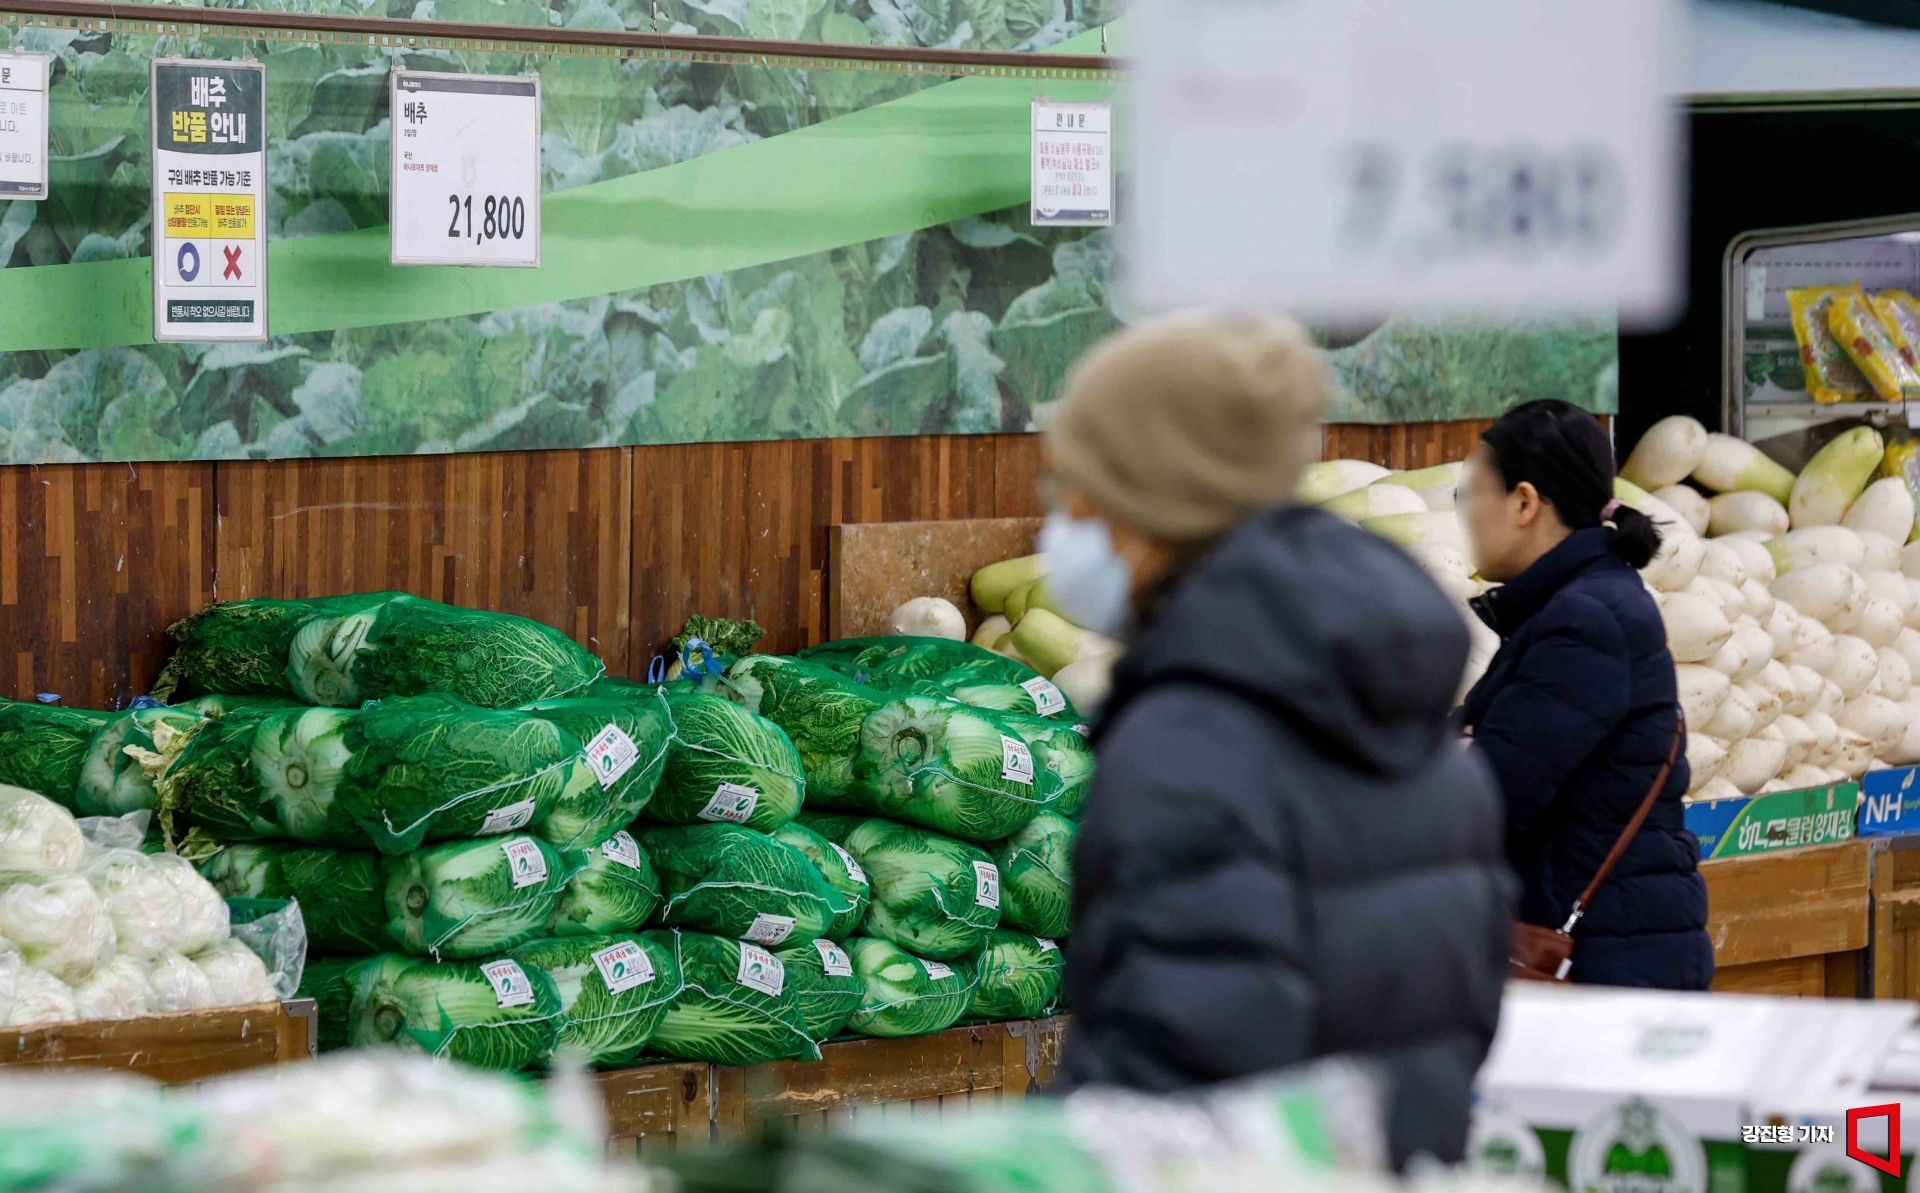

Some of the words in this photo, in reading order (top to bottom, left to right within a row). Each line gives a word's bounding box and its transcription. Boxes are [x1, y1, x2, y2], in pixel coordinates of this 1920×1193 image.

[191, 76, 226, 108] 배추
[172, 112, 207, 142] 반품
[210, 112, 246, 144] 안내
[404, 102, 428, 124] 배추
[168, 169, 183, 186] 구입
[184, 170, 201, 186] 배추
[203, 170, 218, 186] 반품
[220, 171, 235, 186] 가능
[236, 171, 251, 186] 기준
[448, 194, 525, 246] 21,800
[190, 306, 202, 317] 착오
[226, 306, 250, 318] 바랍니다
[1865, 791, 1904, 825] NH
